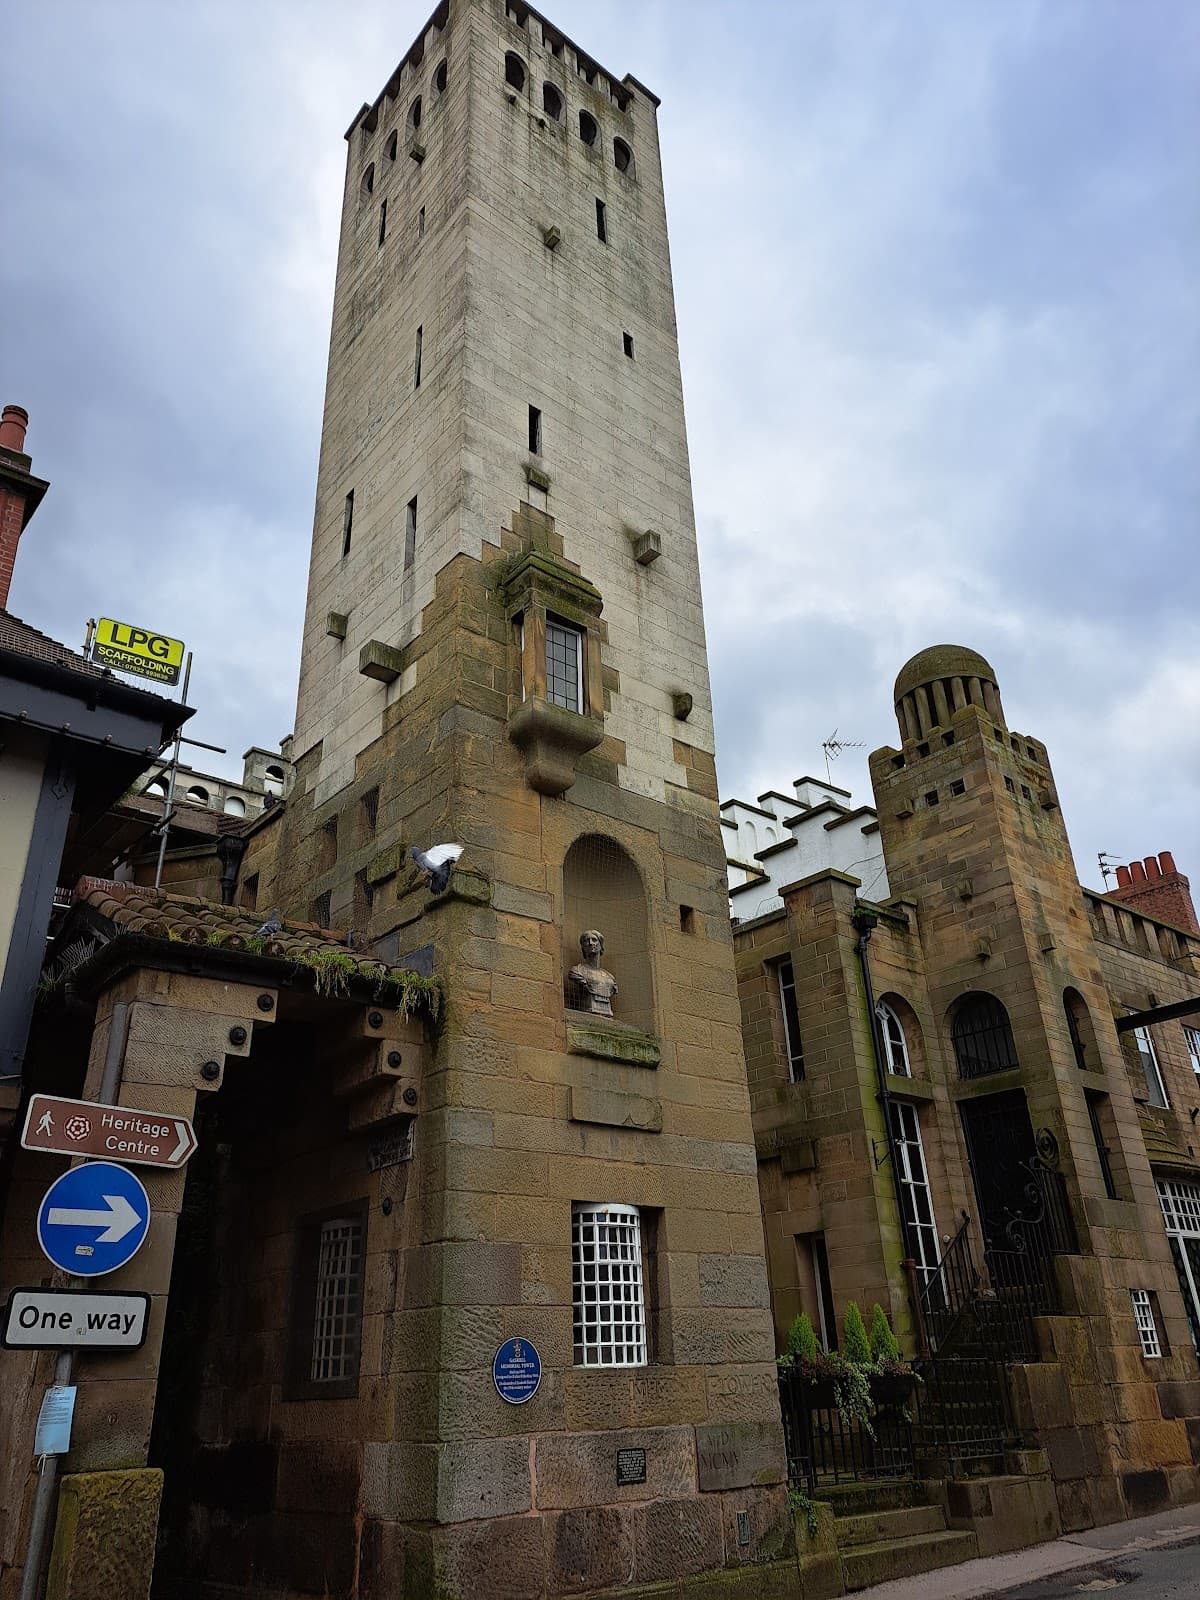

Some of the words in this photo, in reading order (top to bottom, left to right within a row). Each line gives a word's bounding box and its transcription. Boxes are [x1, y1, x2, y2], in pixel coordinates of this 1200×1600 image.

[111, 624, 170, 659] LPG
[97, 646, 175, 675] SCAFFOLDING
[101, 1113, 170, 1138] Heritage
[105, 1136, 160, 1156] Centre
[19, 1305, 73, 1329] One
[87, 1313, 136, 1335] way
